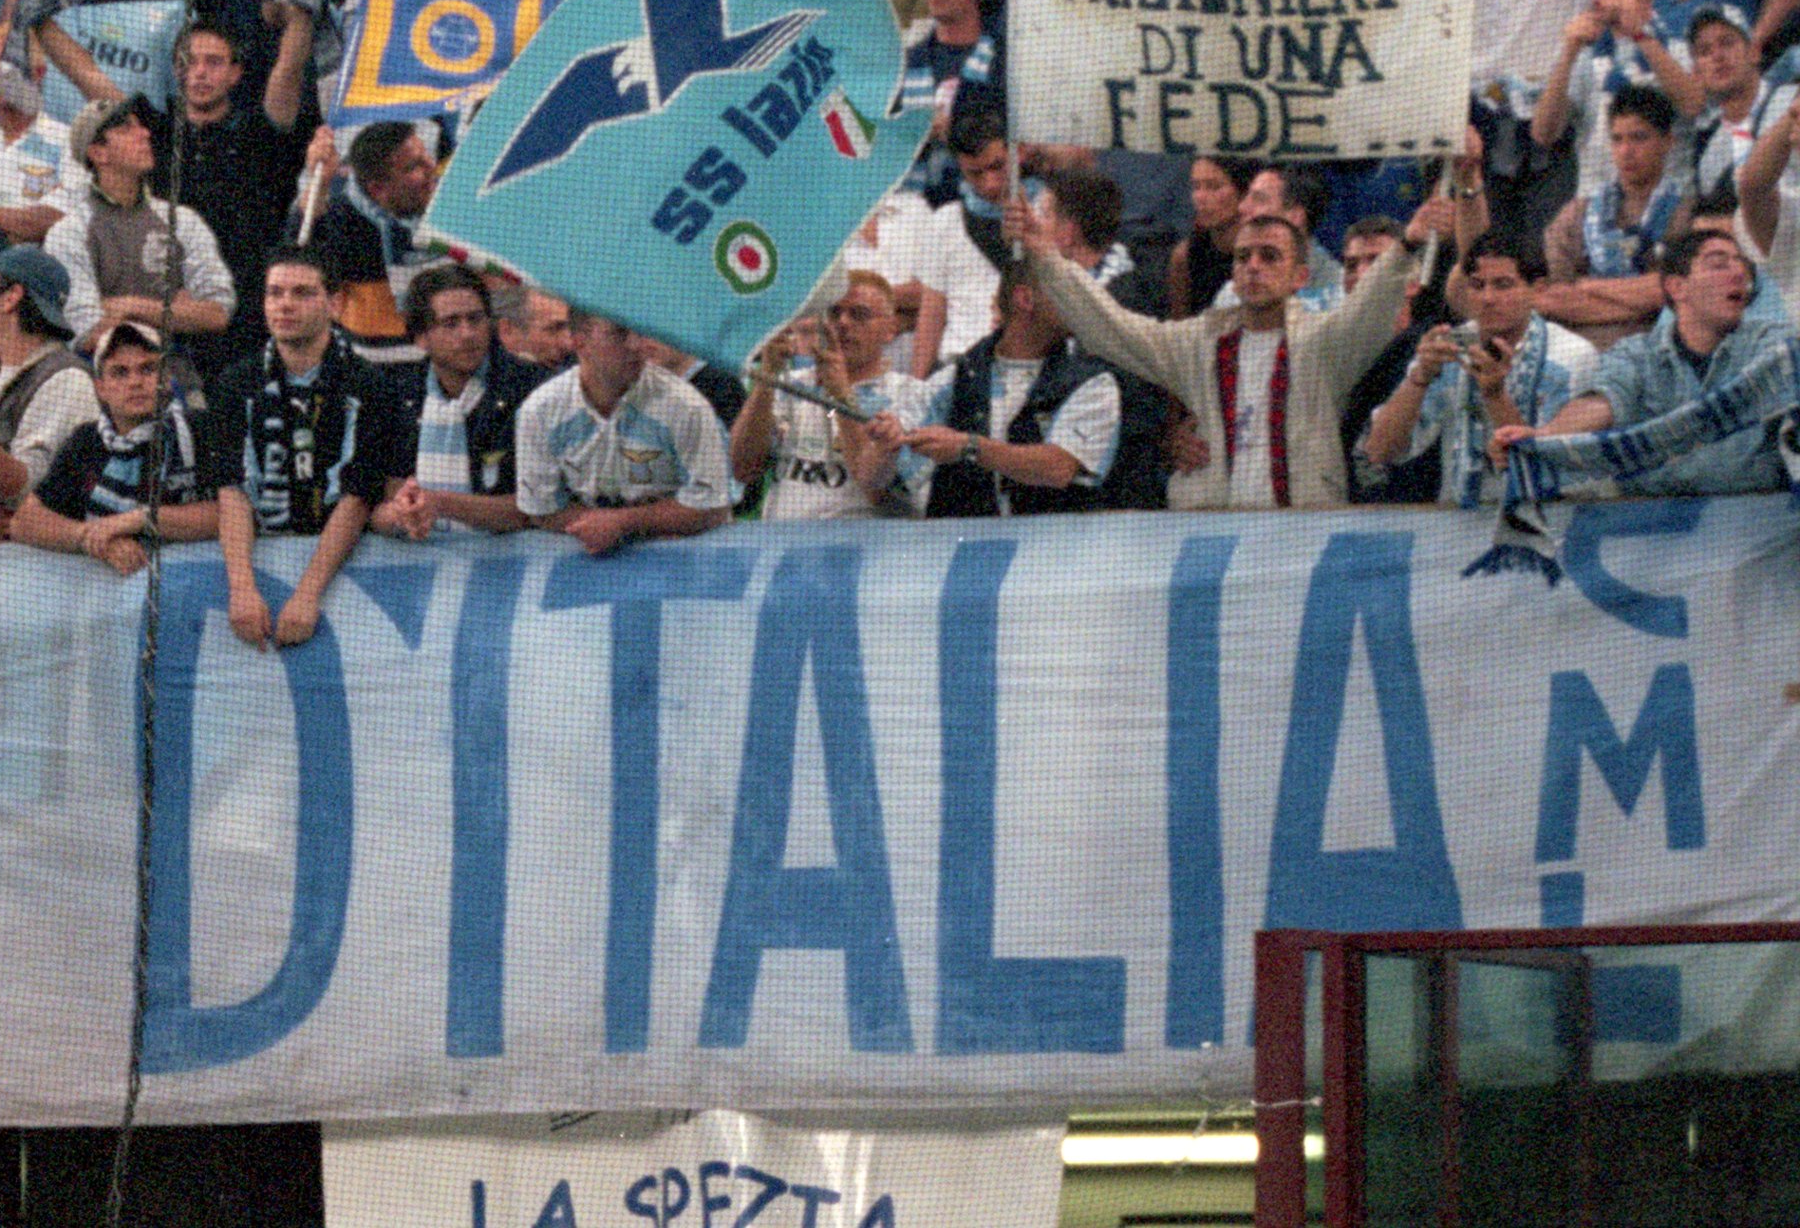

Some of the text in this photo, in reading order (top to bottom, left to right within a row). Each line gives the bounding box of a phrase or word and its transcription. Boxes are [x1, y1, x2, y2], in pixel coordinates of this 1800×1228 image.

[1140, 19, 1386, 90] DI UNA
[651, 144, 747, 245] SS
[136, 528, 1465, 1076] D'ITALIA
